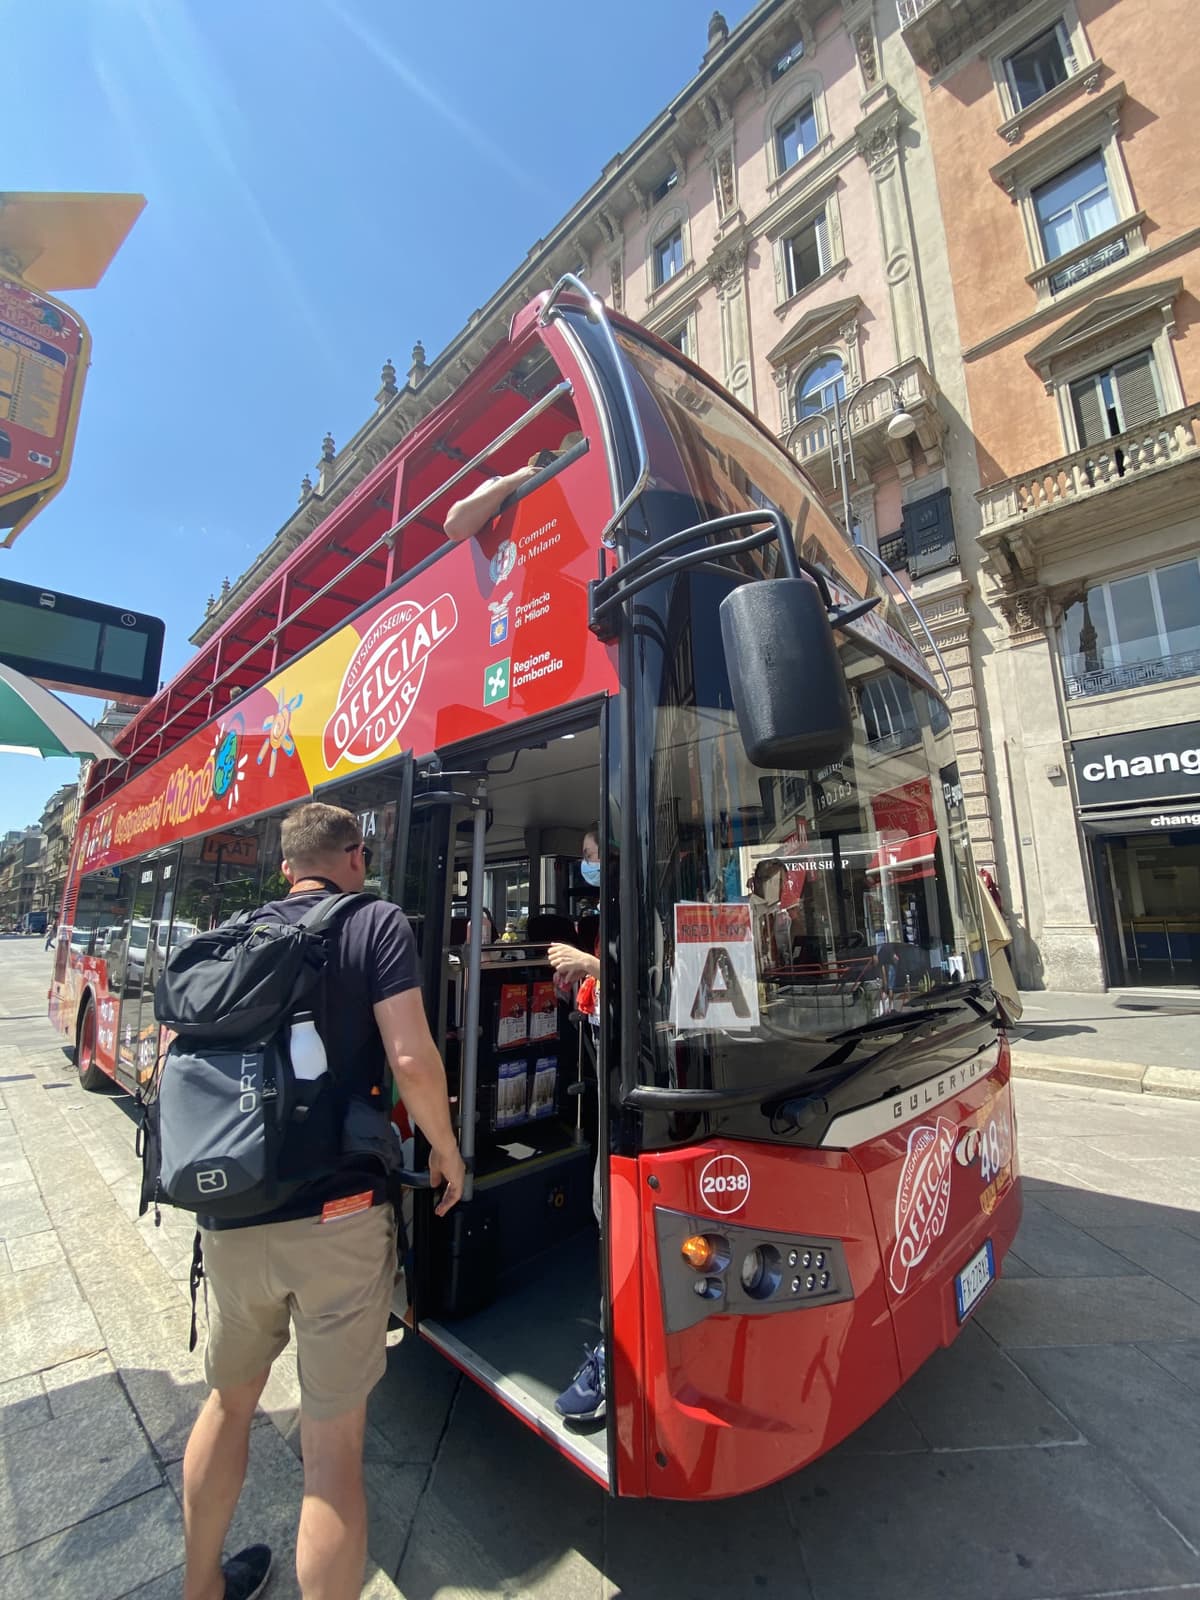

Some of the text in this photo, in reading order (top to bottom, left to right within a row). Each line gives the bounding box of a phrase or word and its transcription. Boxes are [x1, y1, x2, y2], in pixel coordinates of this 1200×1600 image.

[518, 518, 557, 548] Comune
[517, 533, 561, 566] di Milano
[514, 604, 550, 628] di Milano
[515, 592, 550, 617] Provincia
[346, 608, 413, 688] CITYSIGHTSEEING
[513, 650, 551, 674] Regione
[334, 608, 447, 749] OFFICIAL
[512, 658, 563, 688] Lombardia
[365, 680, 416, 748] TOUR
[818, 859, 849, 870] SHP
[690, 946, 752, 1020] A
[703, 1174, 748, 1193] 2038
[900, 1126, 954, 1268] OFFICIAL
[926, 1181, 950, 1245] TOUR
